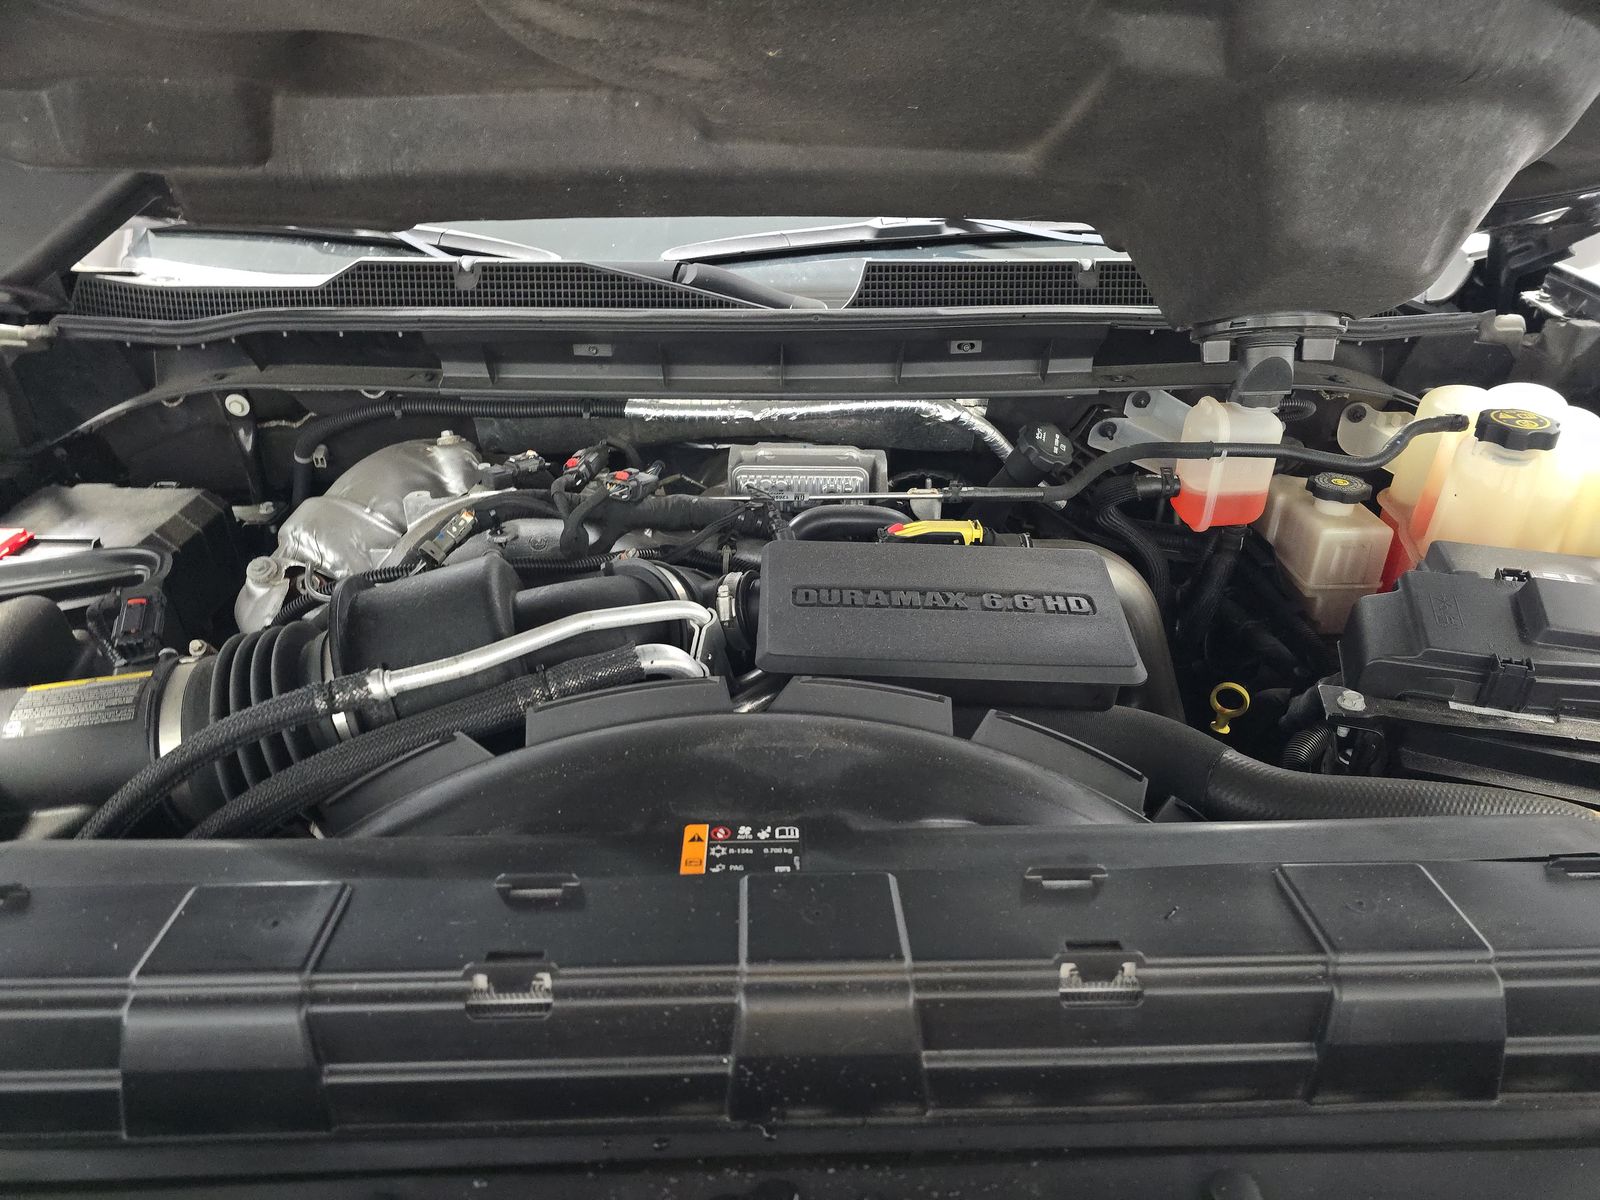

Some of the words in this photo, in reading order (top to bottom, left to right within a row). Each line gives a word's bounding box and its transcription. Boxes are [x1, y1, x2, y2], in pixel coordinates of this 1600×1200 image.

[796, 588, 968, 609] DURAMAX
[981, 592, 1037, 612] 6.6
[1043, 594, 1095, 615] HD
